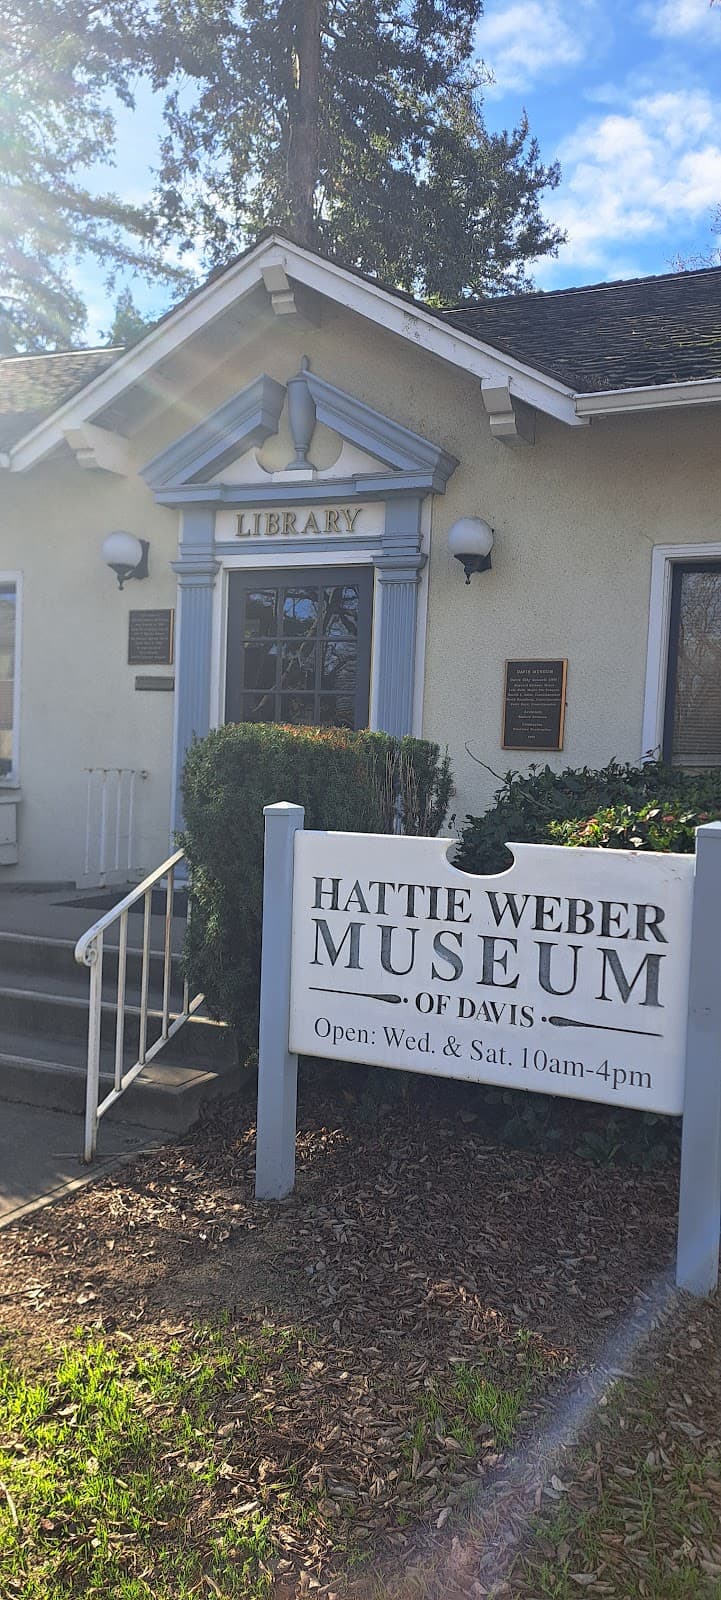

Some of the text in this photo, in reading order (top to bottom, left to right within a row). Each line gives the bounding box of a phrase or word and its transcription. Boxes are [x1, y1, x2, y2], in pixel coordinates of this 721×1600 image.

[235, 508, 362, 537] LIBRARY
[311, 876, 669, 944] HATTIE WEBER
[309, 918, 667, 1008] MUSEUM
[415, 992, 535, 1029] OF DAVIS
[314, 1017, 653, 1090] Open: Wed. & Sat. 10am-4pm
